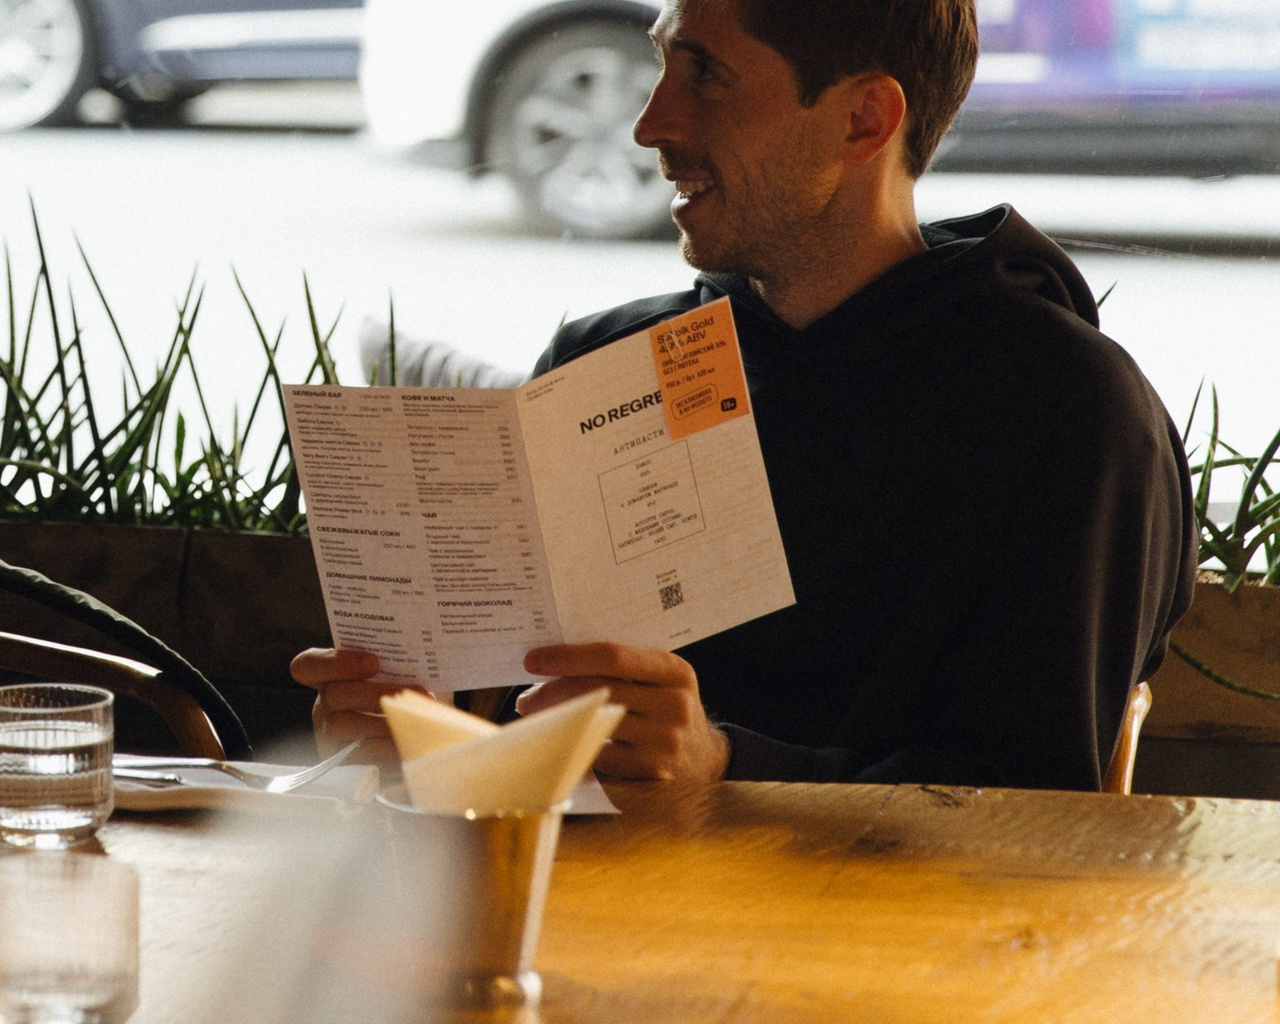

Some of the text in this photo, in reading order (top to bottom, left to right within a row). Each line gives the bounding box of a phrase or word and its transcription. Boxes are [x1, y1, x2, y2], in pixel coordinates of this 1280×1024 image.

[690, 316, 714, 332] Gold
[686, 330, 706, 345] ABV
[679, 343, 715, 360] НГЛИЙСКИЙ
[292, 389, 342, 399] ЗЕЛЕНЫЙ БАР
[579, 389, 664, 435] NO REGRE
[613, 428, 665, 455] АНТИПАСТИ
[316, 526, 400, 537] СВЕЖЕВЫЖАТЫЕ СОКИ
[326, 571, 412, 584] ДОМАШНИЕ ЛИМОНАДЫ
[437, 599, 513, 608] ГОРЯЧИЙ ШОКОЛАД
[333, 610, 353, 618] ВОДА
[360, 612, 395, 622] СОДОВАЯ
